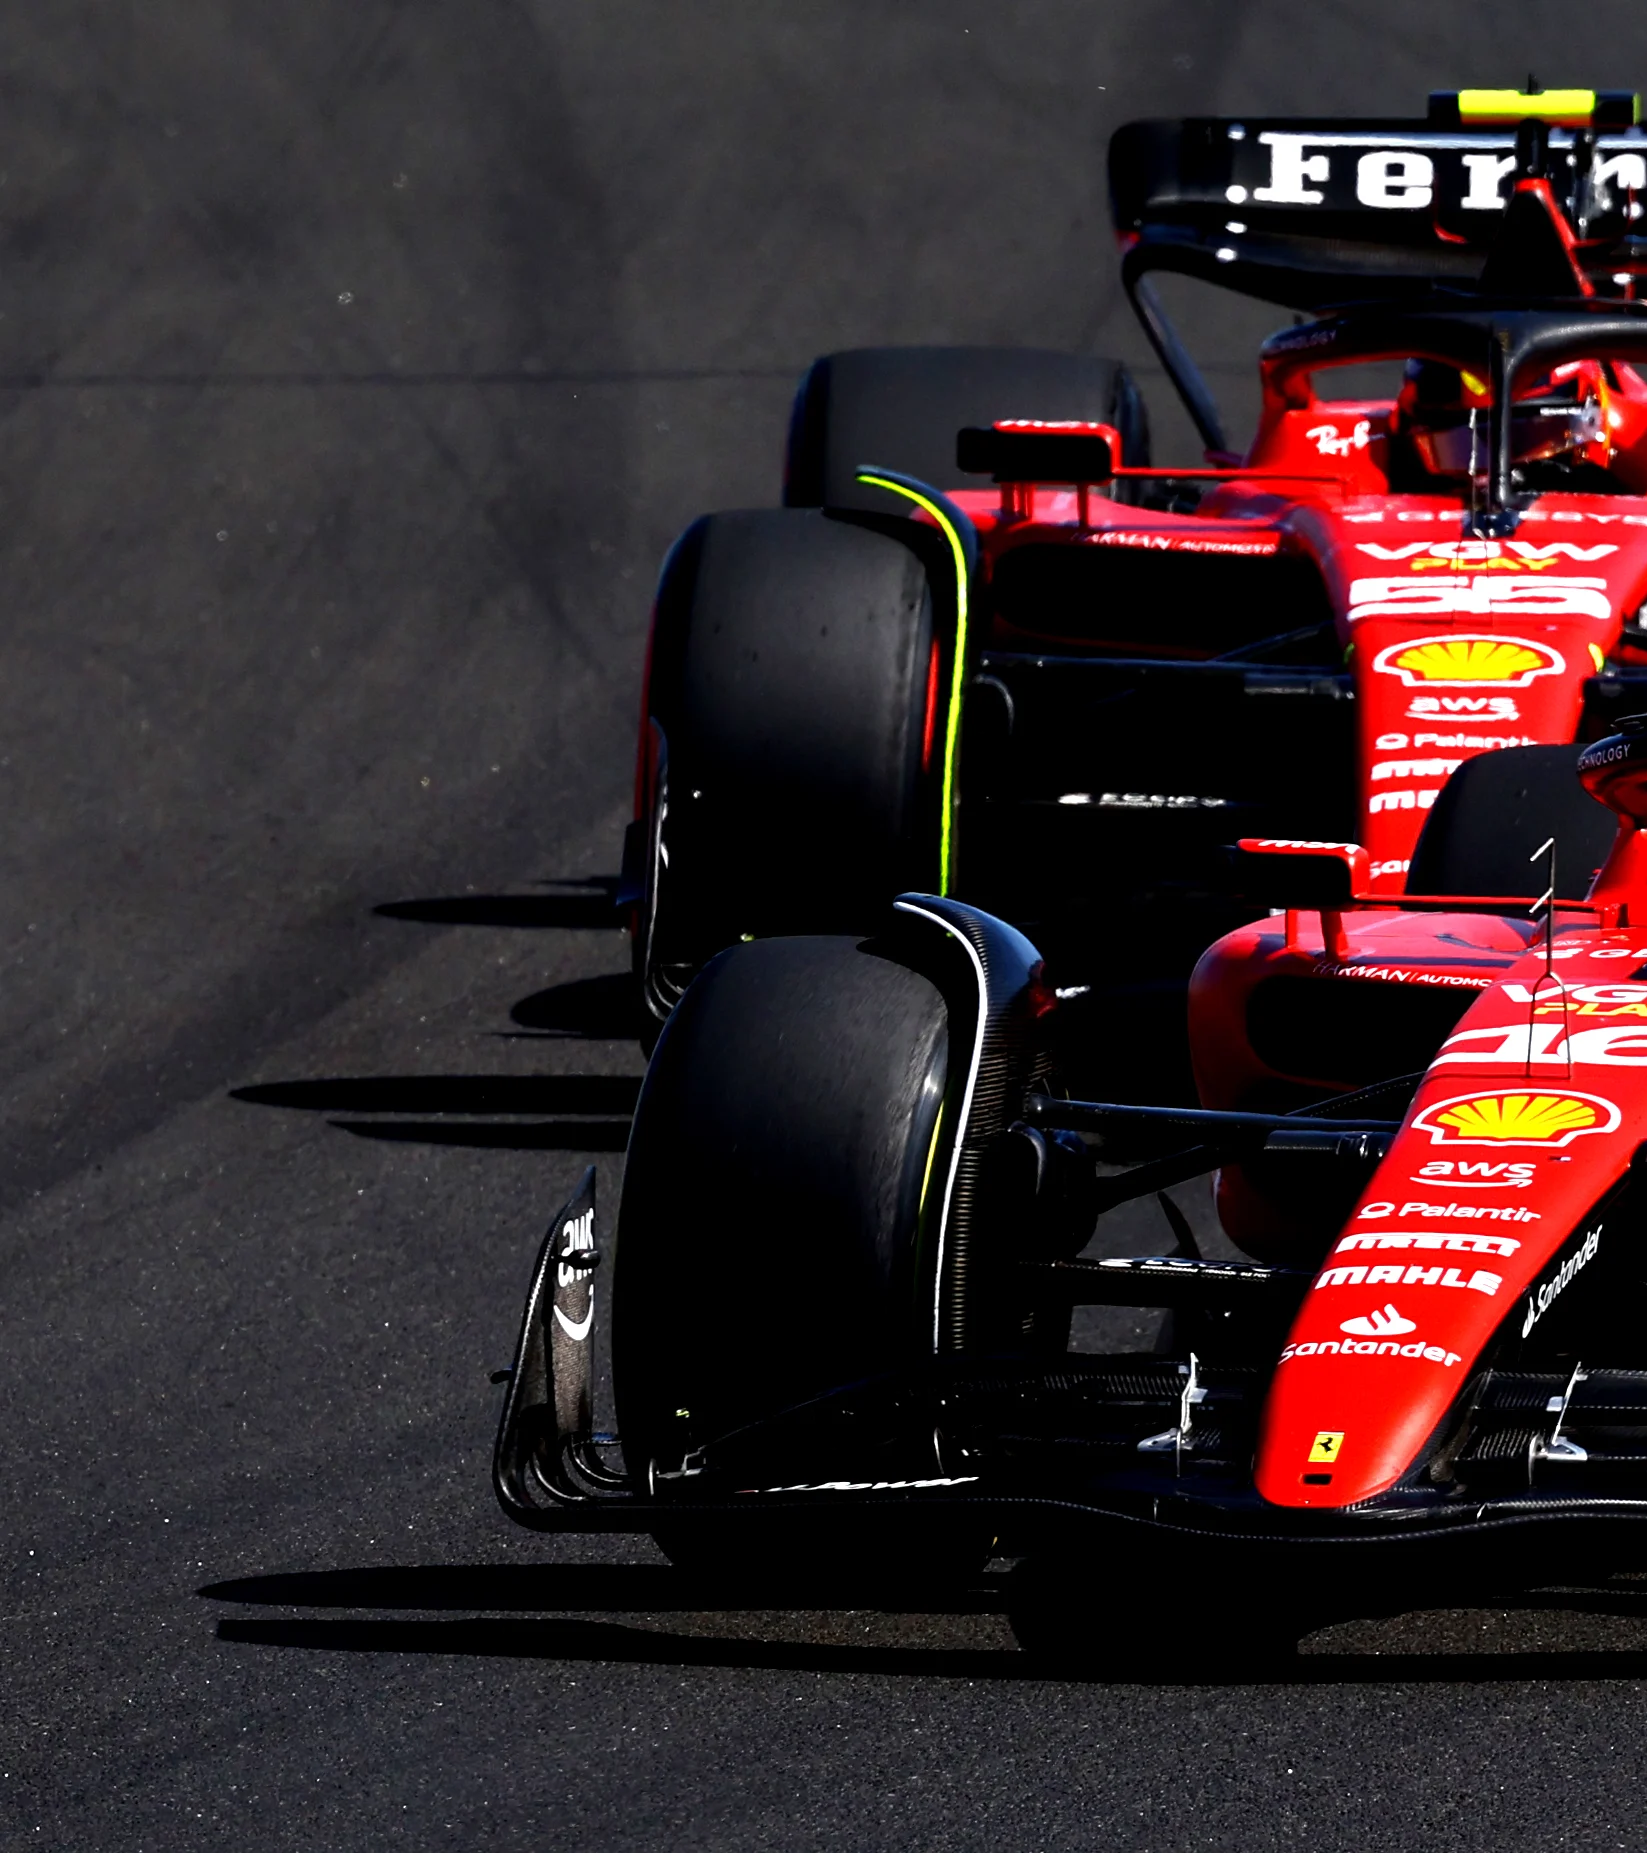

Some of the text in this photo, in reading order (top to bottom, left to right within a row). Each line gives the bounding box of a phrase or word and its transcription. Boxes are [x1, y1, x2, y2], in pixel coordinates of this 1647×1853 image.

[1305, 420, 1386, 457] Ray-B
[1355, 541, 1619, 560] VGW
[1410, 558, 1558, 571] PLAY
[1347, 576, 1612, 621] 55
[1409, 697, 1517, 712] aws
[1577, 743, 1631, 771] ECHNOLOGY
[1418, 1160, 1537, 1179] aws
[1398, 1201, 1542, 1223] Palantir
[1334, 1231, 1522, 1258] PIRELLI
[1314, 1265, 1503, 1296] MAHLE
[1534, 1224, 1604, 1323] Santander
[1278, 1338, 1463, 1367] Santander
